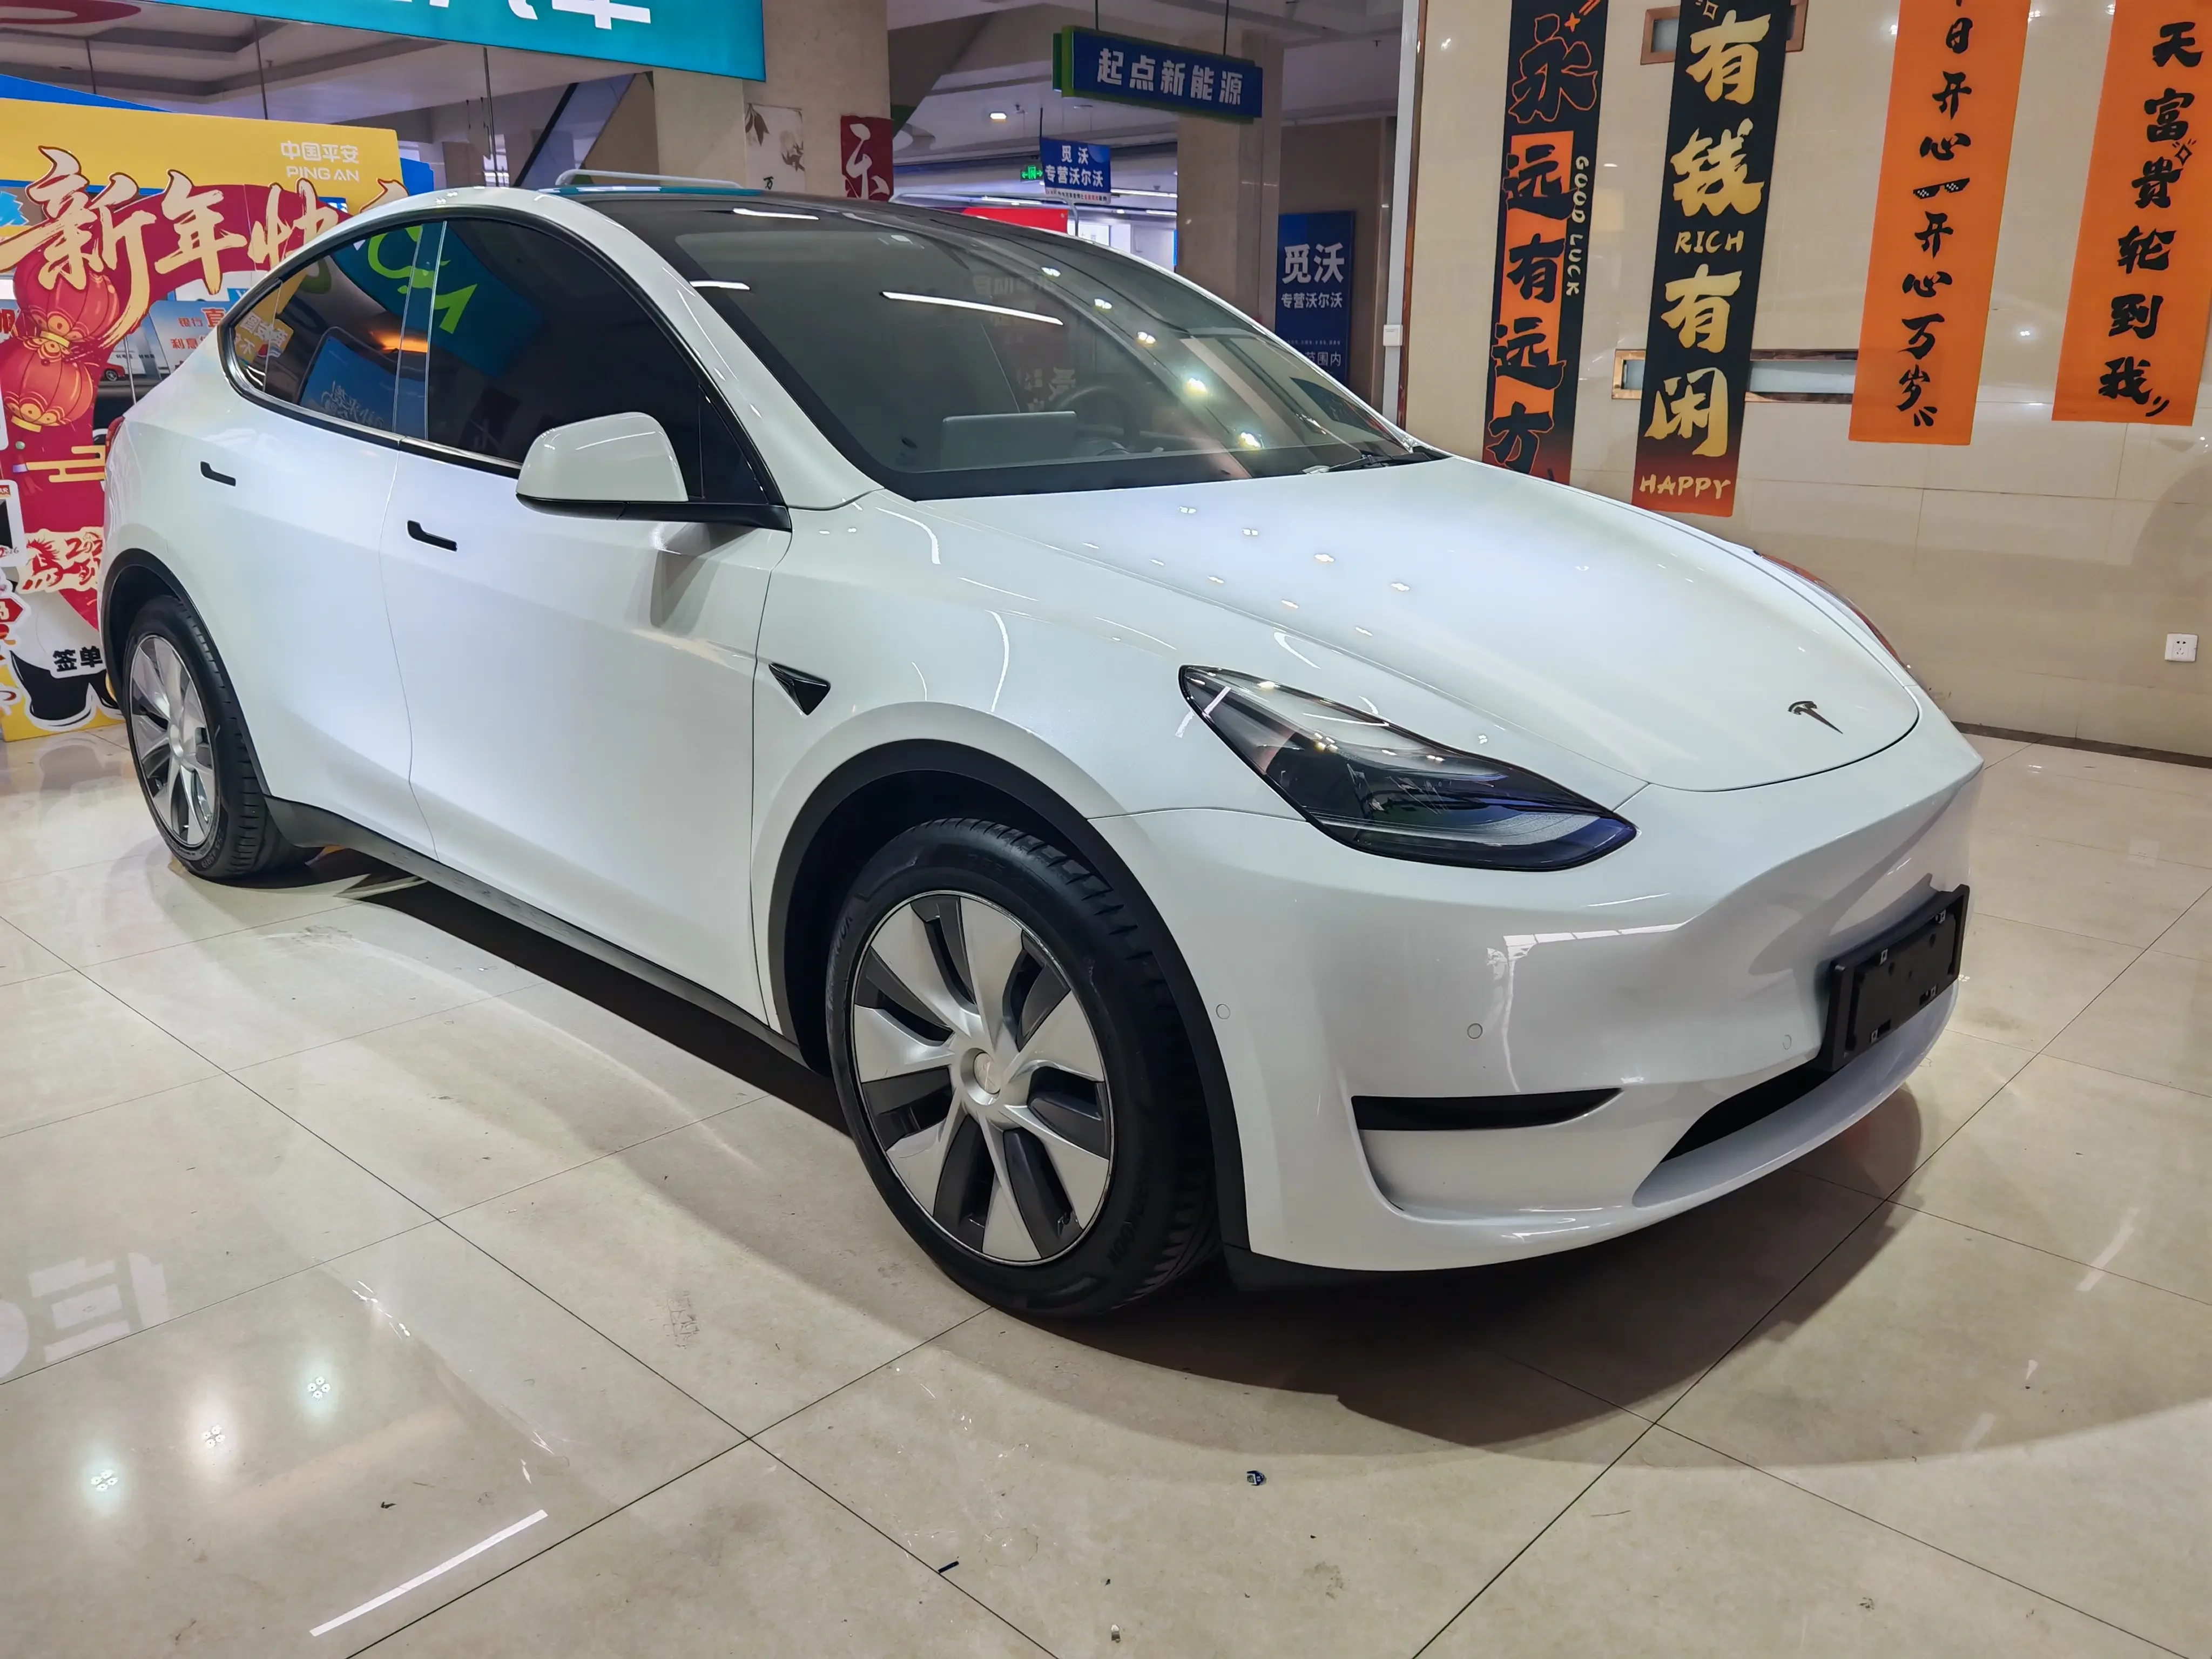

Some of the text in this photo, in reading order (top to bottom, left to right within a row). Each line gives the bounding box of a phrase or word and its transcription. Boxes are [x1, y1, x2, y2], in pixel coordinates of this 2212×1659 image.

[1097, 48, 1244, 105] 起点新能源
[1669, 10, 1770, 217] 有钱
[280, 140, 359, 164] 中国平安
[1061, 145, 1089, 165] 觅沃
[286, 166, 359, 182] PING AN
[1045, 165, 1104, 187] 专营沃尔沃
[1566, 156, 1589, 296] GOOD LUCK
[0, 146, 409, 348] 新年快
[1675, 230, 1744, 253] RICH
[1282, 242, 1345, 284] 觅沃
[1281, 292, 1343, 308] 专营沃尔沃
[1644, 265, 1742, 457] 有闲
[1639, 474, 1731, 500] HAPPY
[52, 646, 103, 672] 签单
